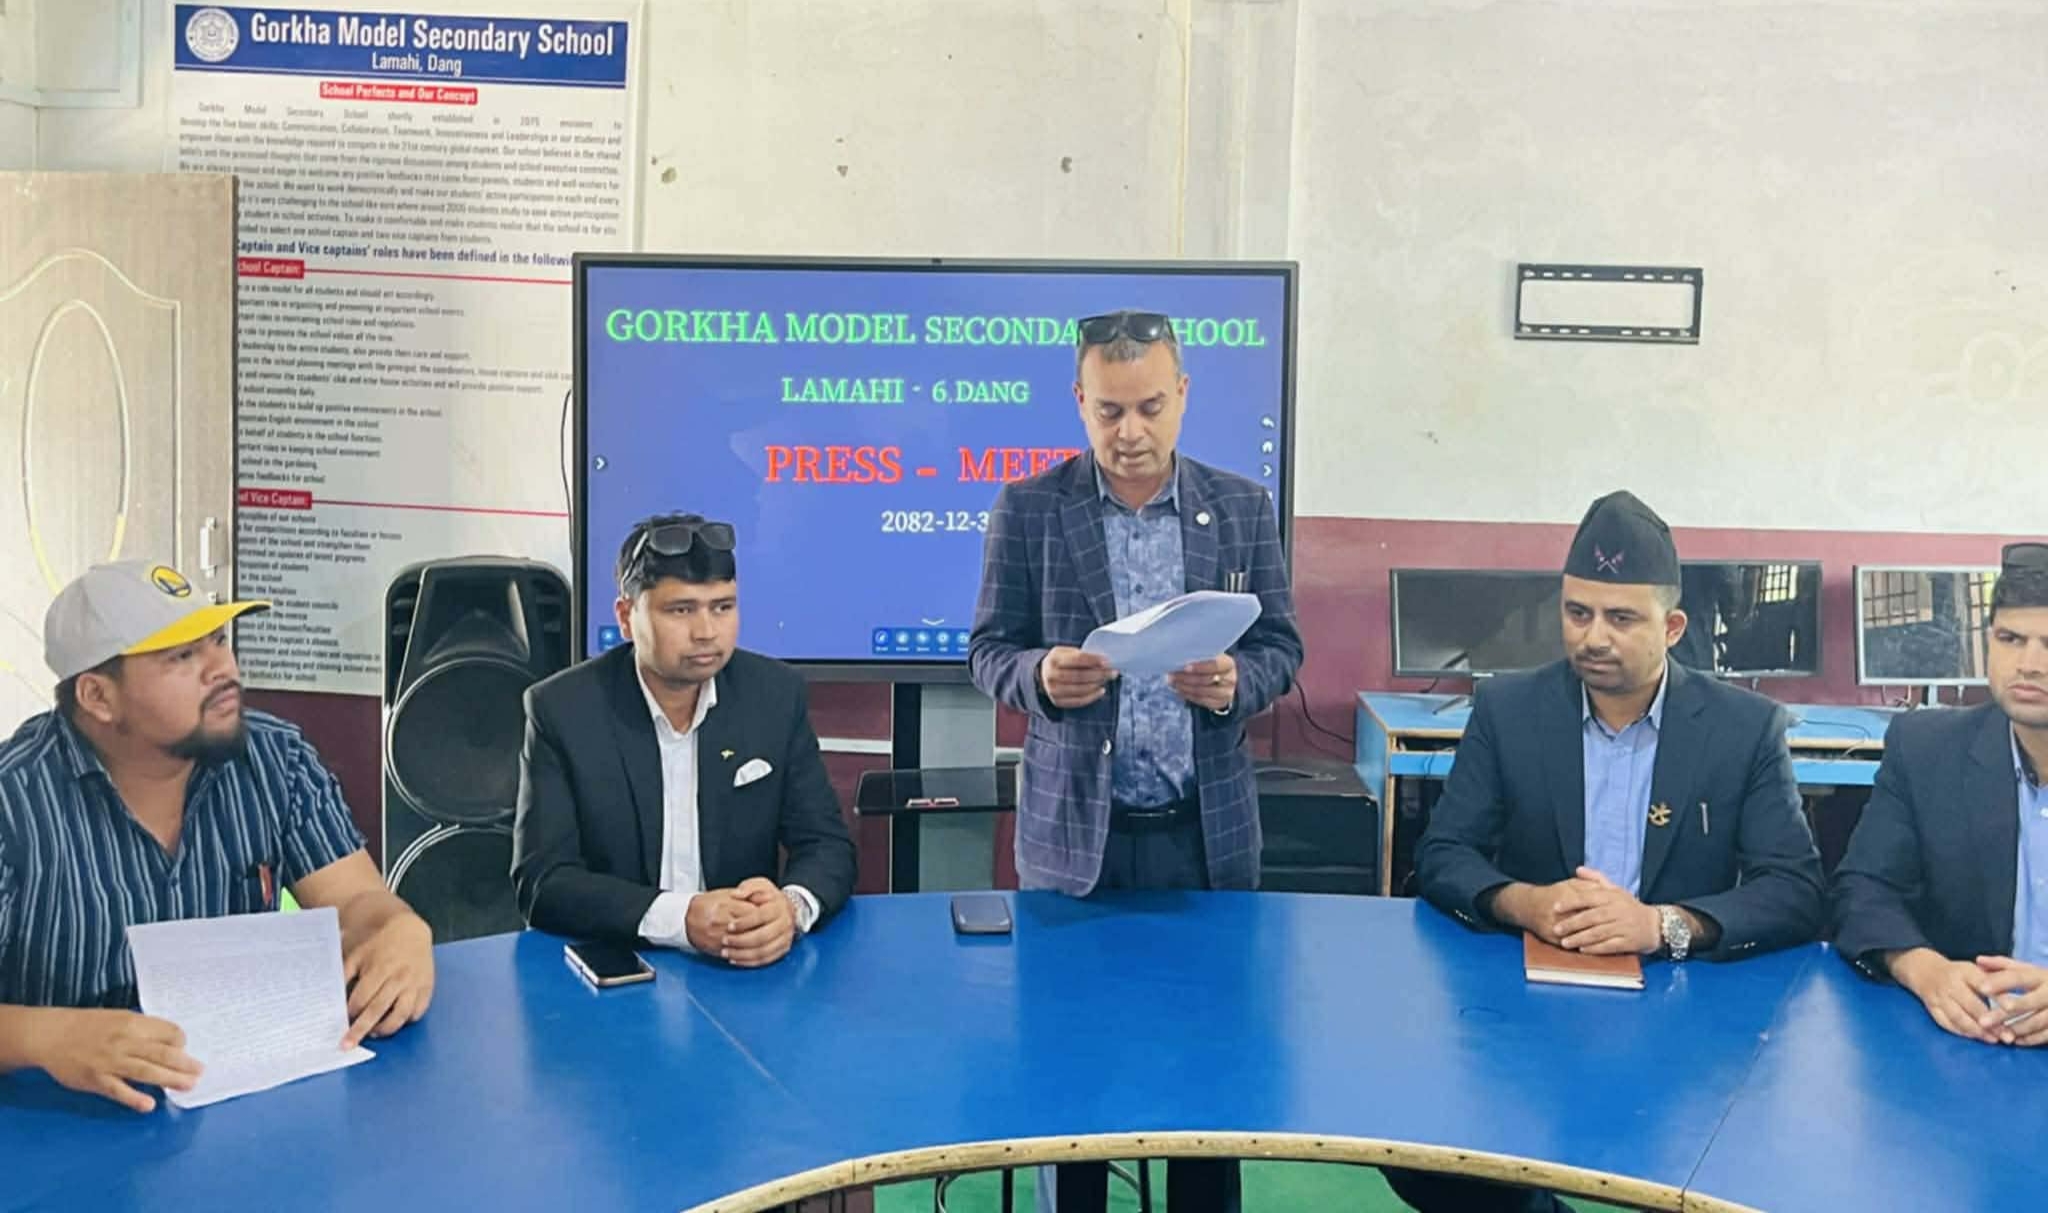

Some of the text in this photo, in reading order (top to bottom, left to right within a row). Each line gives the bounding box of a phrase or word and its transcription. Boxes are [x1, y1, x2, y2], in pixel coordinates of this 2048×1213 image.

[251, 12, 331, 44] Gorkha
[338, 16, 405, 48] Model
[413, 19, 530, 59] Secondary
[538, 24, 613, 56] School
[372, 52, 462, 77] Lamahi, Dang
[322, 83, 353, 95] School
[398, 86, 415, 98] and
[417, 87, 434, 99] Our
[437, 87, 475, 104] Concept
[237, 240, 273, 255] aptain
[276, 242, 295, 254] and
[298, 242, 320, 255] Vice
[373, 245, 399, 258] roles
[402, 247, 427, 259] have
[430, 248, 454, 260] been
[457, 249, 496, 262] defined
[499, 252, 509, 262] in
[512, 251, 529, 263] the
[239, 260, 262, 273] chool
[606, 309, 1265, 347] GORKHA MODEL SECONDA HOOL
[781, 377, 904, 403] LAMAHI
[765, 446, 903, 483] PRESS
[250, 492, 269, 504] Vice
